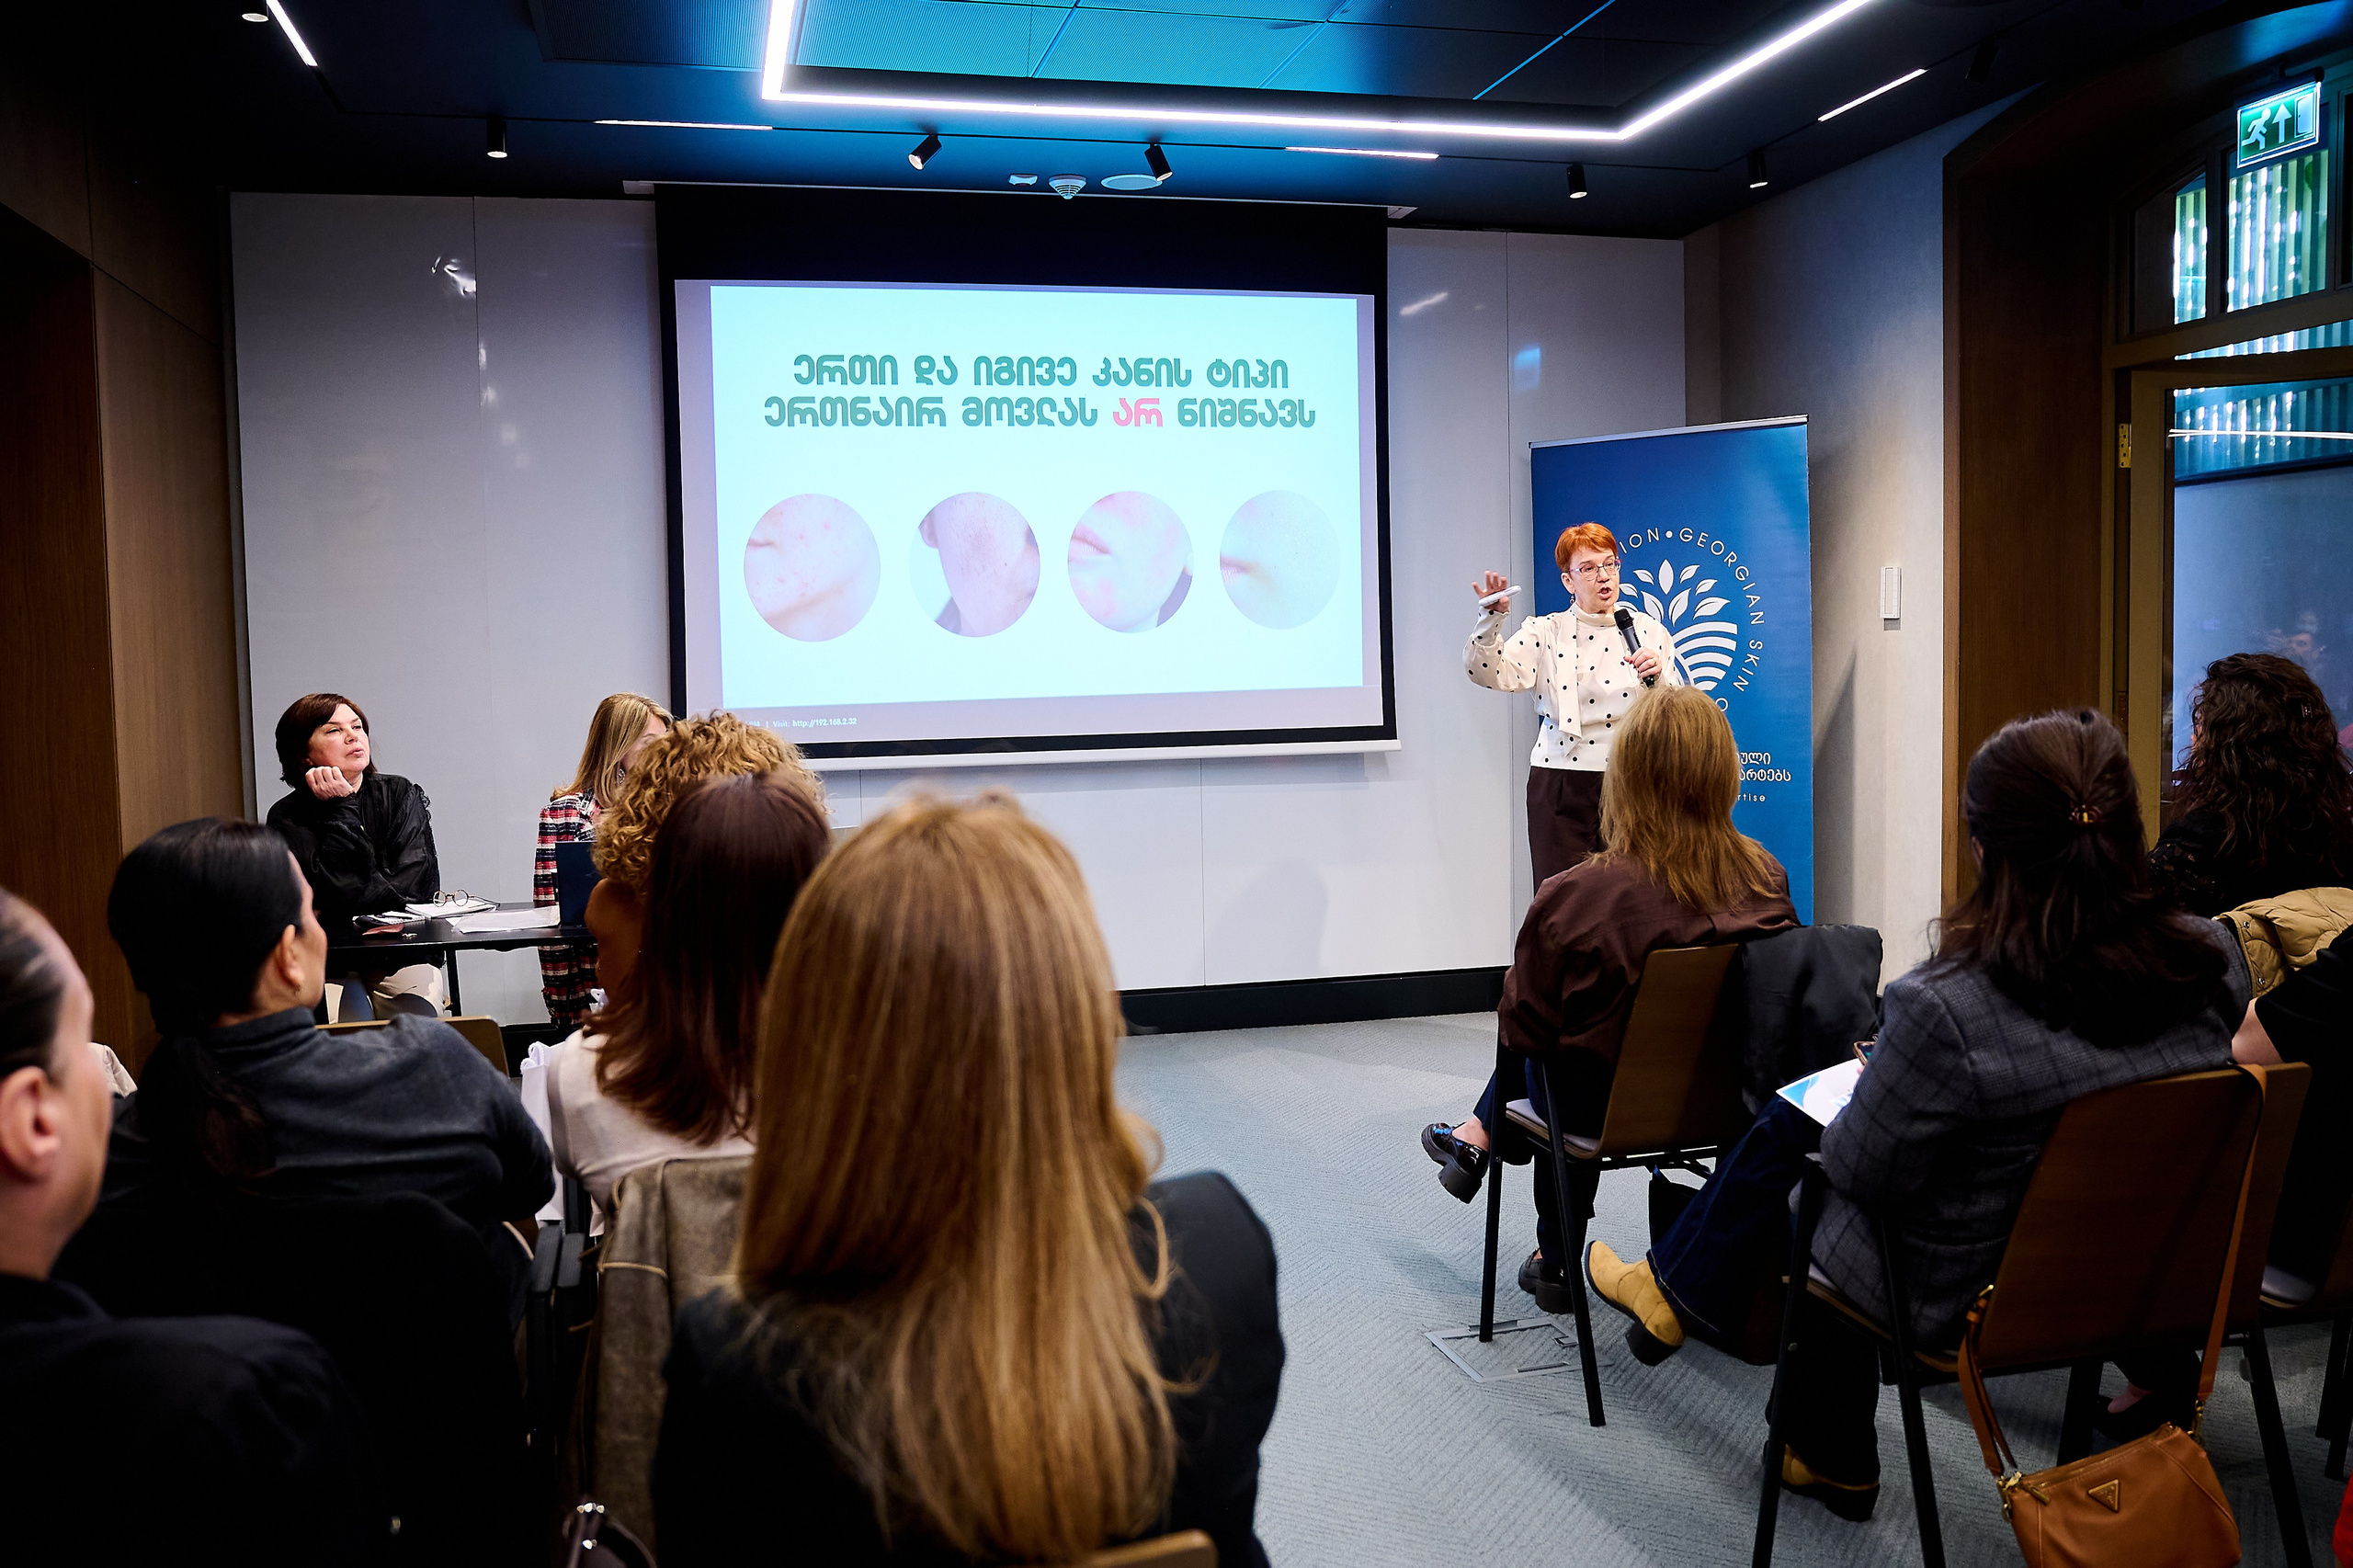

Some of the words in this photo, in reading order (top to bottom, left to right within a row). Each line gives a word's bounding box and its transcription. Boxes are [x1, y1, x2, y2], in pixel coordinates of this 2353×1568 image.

[793, 354, 899, 386] ერთი
[914, 355, 959, 386] და
[973, 356, 1077, 386] იგივე
[1092, 357, 1192, 388] კანის
[1206, 358, 1289, 389] ტიპი
[764, 396, 947, 426] ერთნაირ
[961, 396, 1098, 427] მოვლას
[1112, 397, 1164, 427] არ
[1177, 398, 1316, 428] ნიშნავს
[1679, 528, 1765, 625] GEORGIAN
[1733, 639, 1763, 692] SKIN
[772, 720, 790, 728] Visit:
[792, 717, 858, 728] http://192.168.2.32
